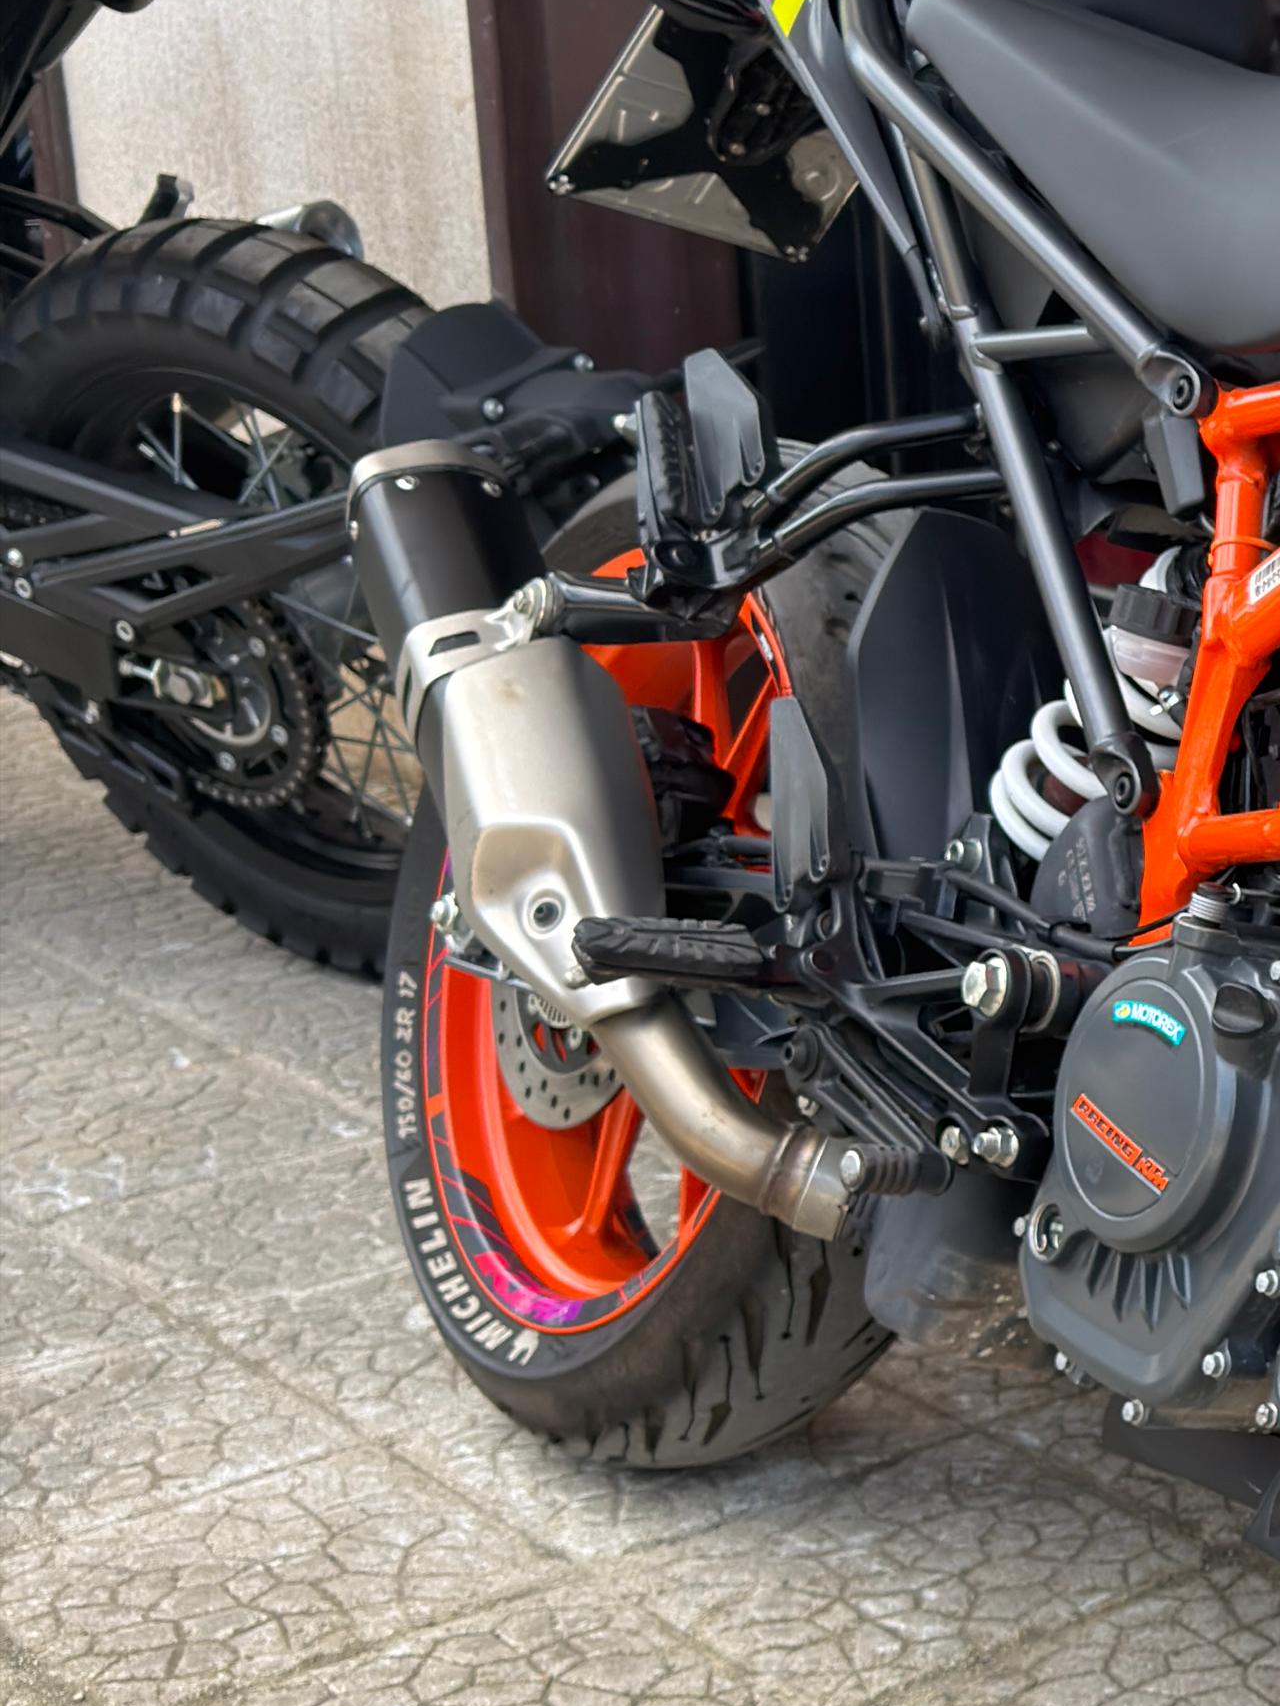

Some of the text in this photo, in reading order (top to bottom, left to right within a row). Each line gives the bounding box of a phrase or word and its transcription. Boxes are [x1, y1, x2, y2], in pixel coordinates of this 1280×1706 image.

[1131, 1003, 1182, 1044] MOTOREX
[1077, 1099, 1169, 1192] RACING KTM
[405, 1178, 515, 1353] MICHELIN
